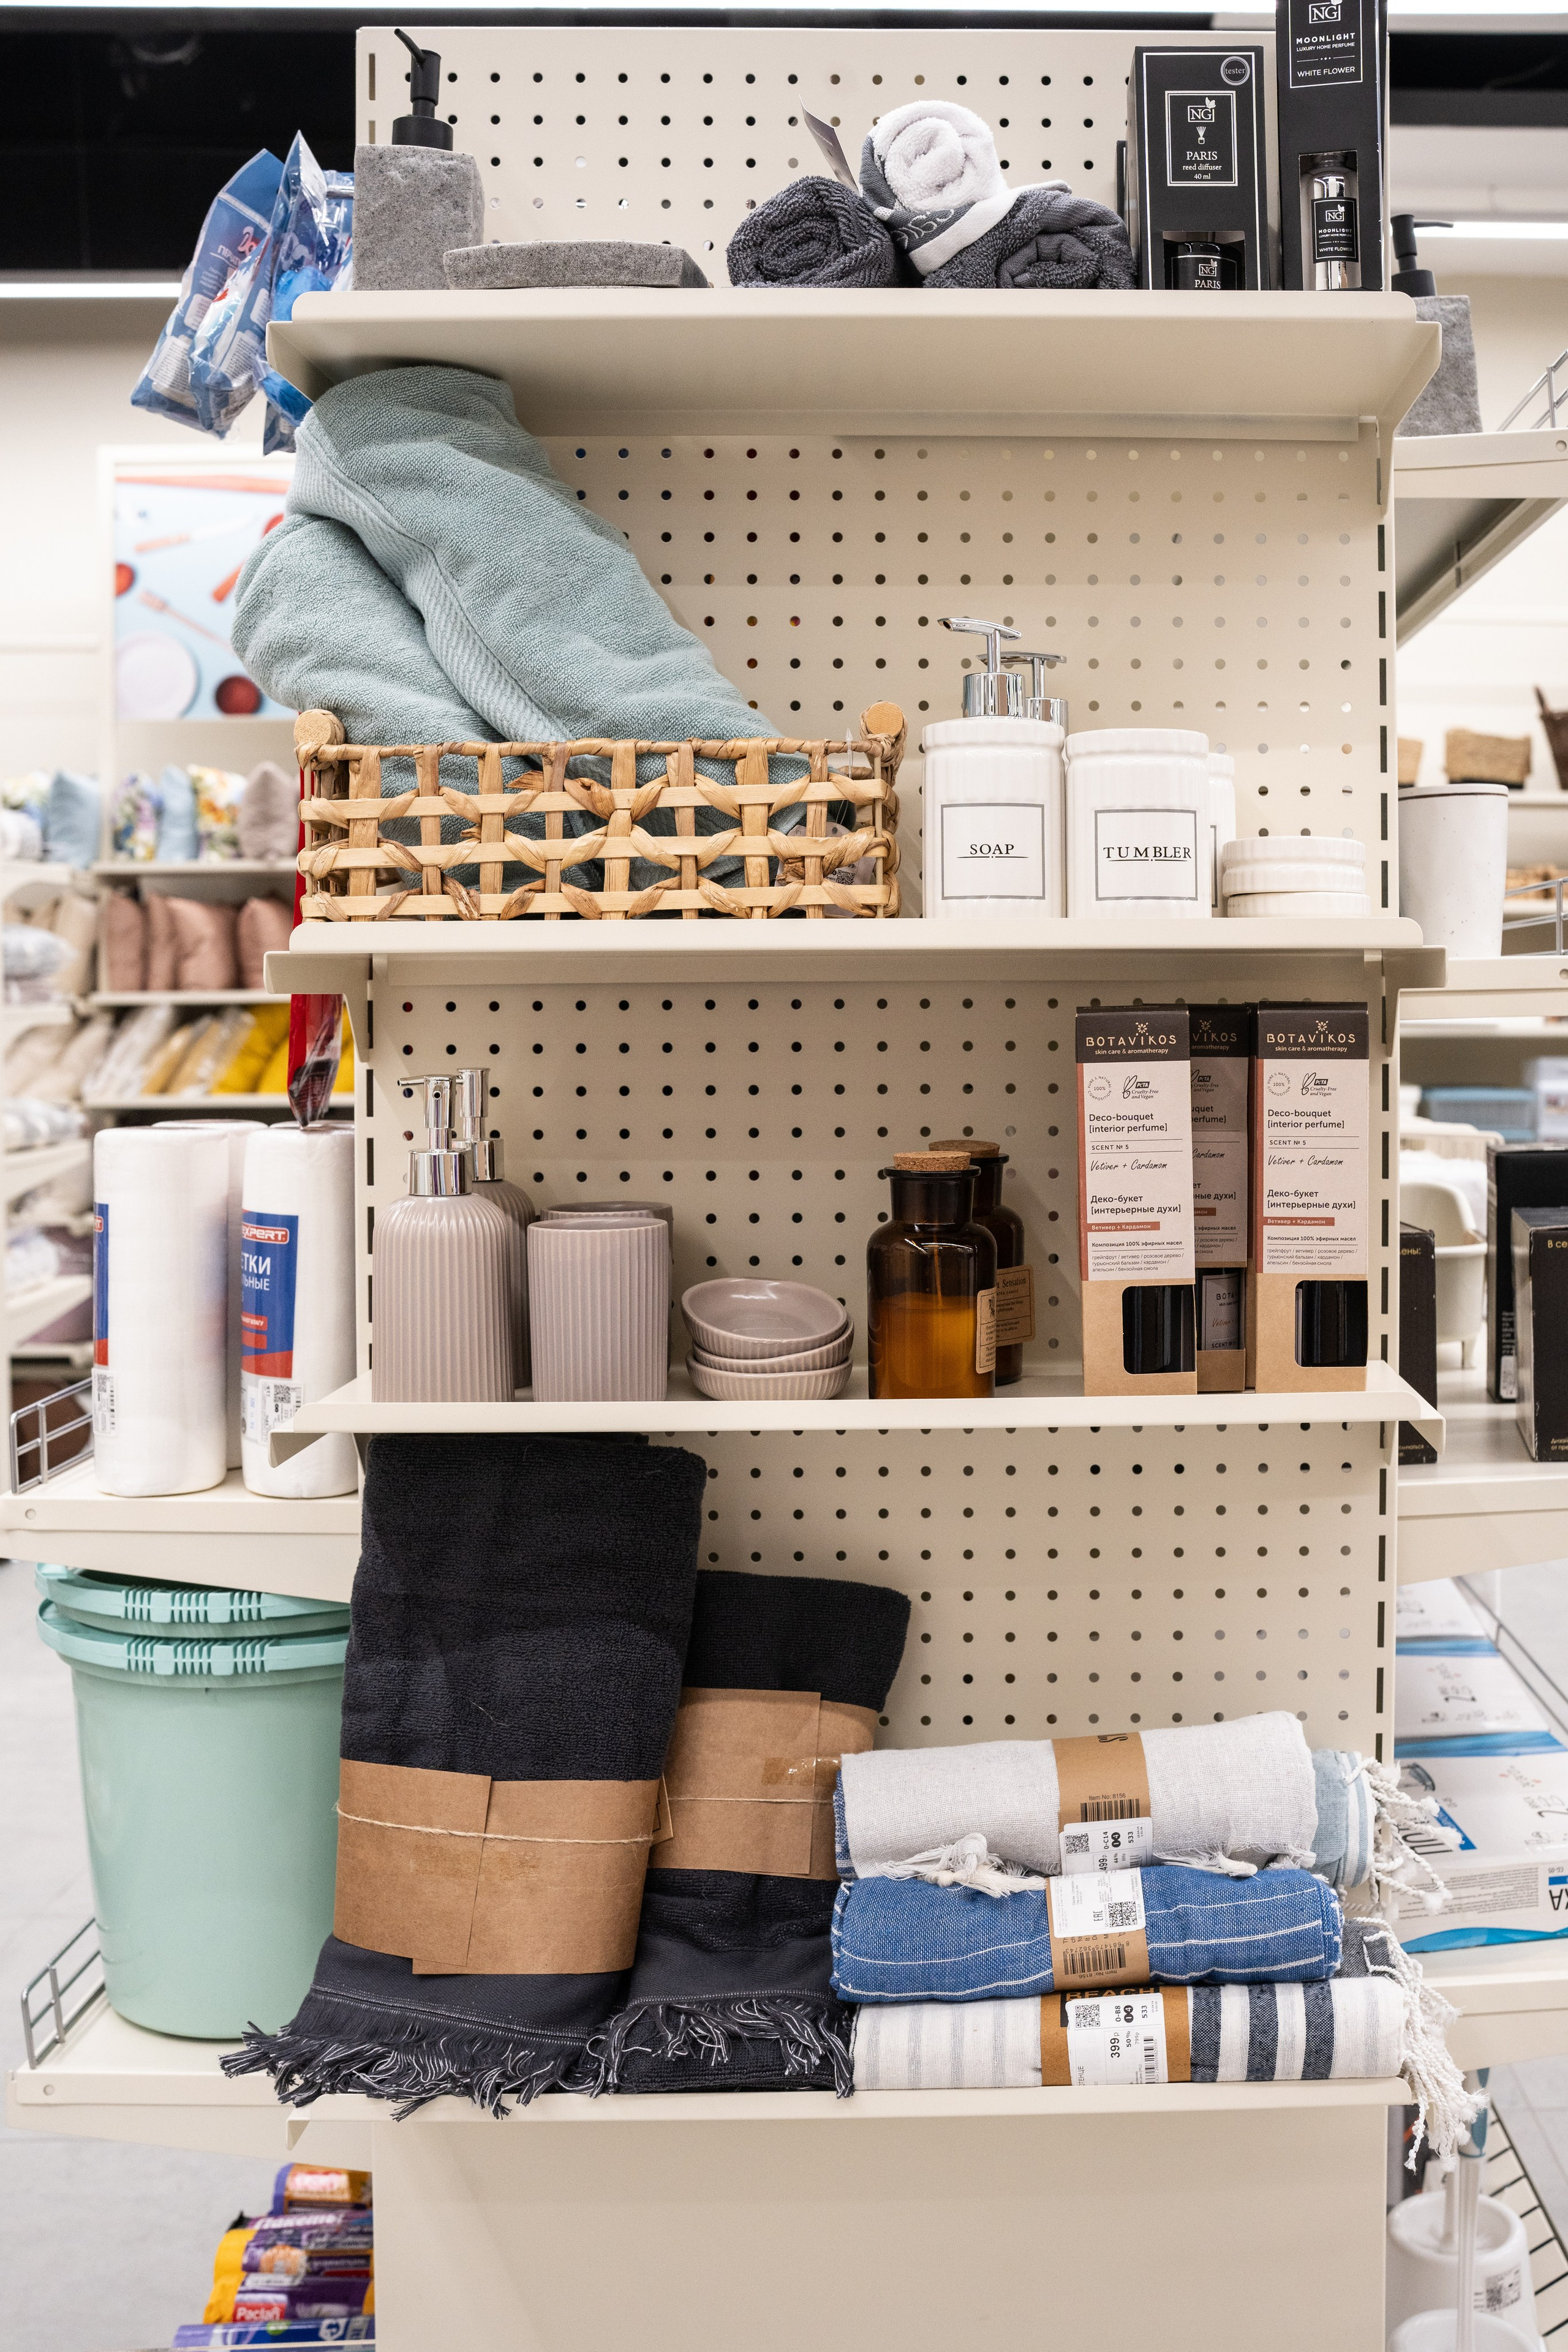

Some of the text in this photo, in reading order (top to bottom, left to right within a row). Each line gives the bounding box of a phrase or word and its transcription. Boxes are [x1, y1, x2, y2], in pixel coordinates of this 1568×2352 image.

[1312, 6, 1338, 20] NG
[1296, 33, 1355, 44] MOONLIGHT
[1324, 66, 1355, 75] FLOWER
[1191, 109, 1212, 119] NG
[1186, 151, 1218, 160] PARIS
[1195, 280, 1221, 289] PARIS
[970, 843, 1014, 856] SOAP
[1103, 846, 1191, 859] TUMBLER
[1086, 1035, 1177, 1046] BOTAVIKOS
[1267, 1034, 1355, 1043] BOTAVIKOS
[1088, 1090, 1112, 1101] COMPOSITION
[1267, 1086, 1291, 1096] COMPOSITION
[1268, 1109, 1331, 1118] Deco-bouquet
[1127, 1123, 1167, 1133] perfume]
[1305, 1120, 1344, 1129] perfume]
[1091, 1161, 1118, 1171] Vetiver
[1131, 1159, 1167, 1170] Cardamom
[1268, 1155, 1295, 1166] Vetiver
[1308, 1155, 1343, 1166] Cardamom
[1214, 1192, 1236, 1200] духи]
[1267, 1189, 1319, 1198] Деко-букет
[1157, 1205, 1181, 1214] духи]
[1268, 1200, 1355, 1210] [интерьерные духи]
[1002, 1278, 1026, 1287] Sensation
